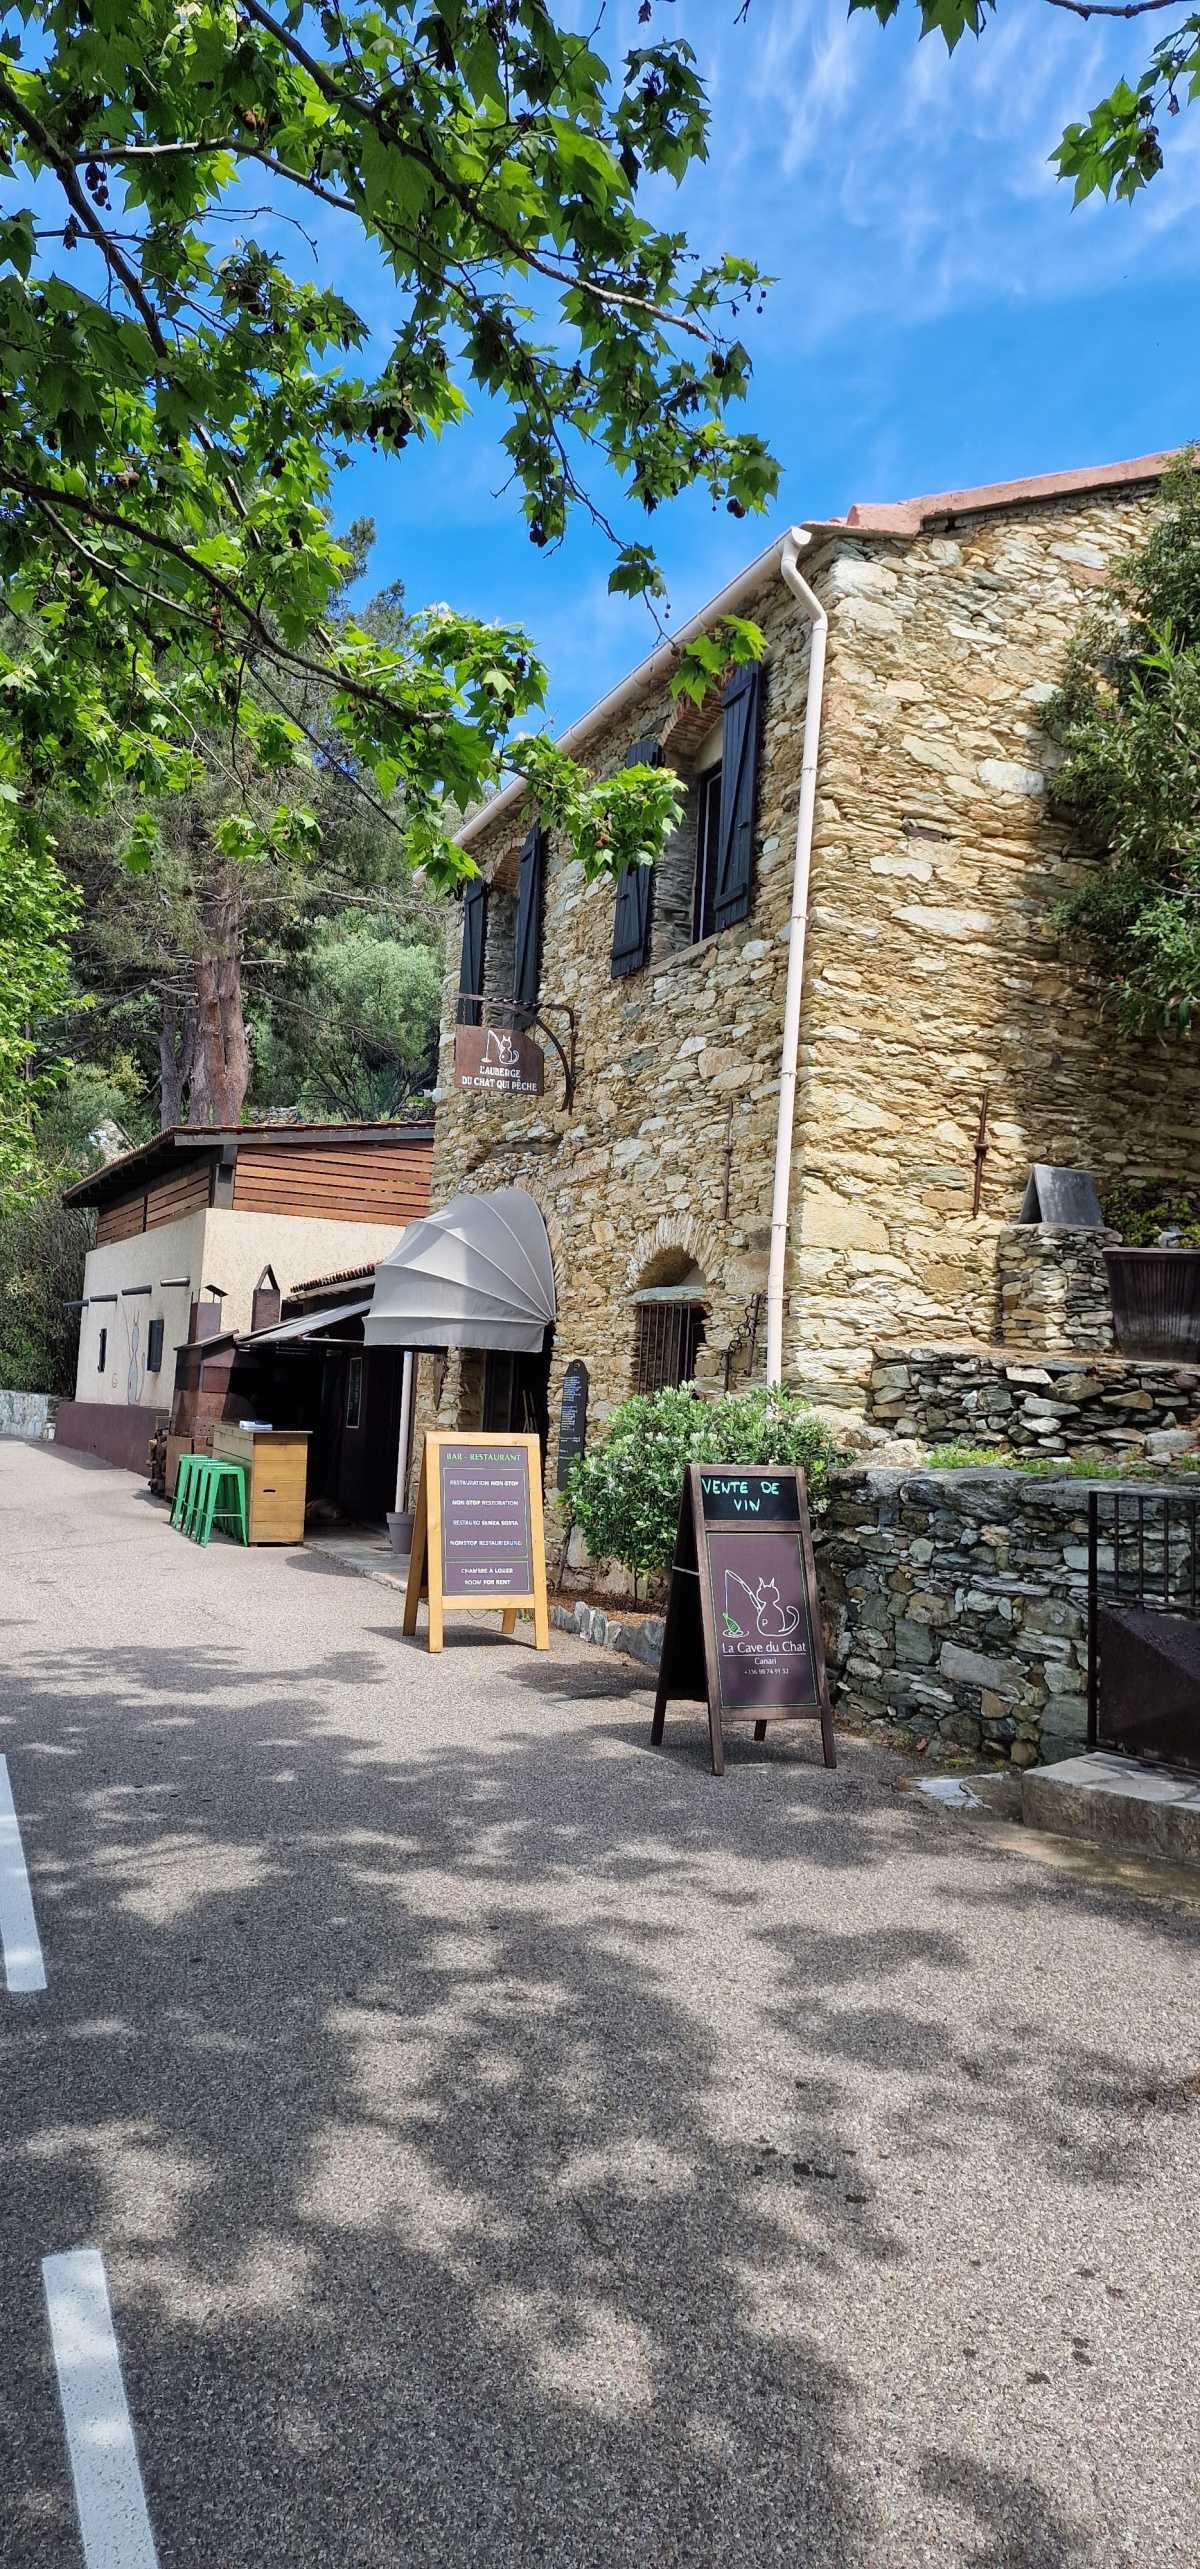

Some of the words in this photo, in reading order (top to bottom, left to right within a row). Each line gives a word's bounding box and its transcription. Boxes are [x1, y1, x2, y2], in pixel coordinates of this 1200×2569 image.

[462, 1075, 473, 1086] DU
[473, 1077, 496, 1088] CHAT
[496, 1080, 510, 1090] QUI
[511, 1079, 538, 1092] PÊCHE
[446, 1453, 462, 1461] BAR
[470, 1453, 521, 1462] RESTAURANT
[701, 1478, 748, 1494] VENTE
[760, 1481, 781, 1495] DE
[733, 1498, 760, 1512] VIN
[722, 1642, 734, 1653] La
[737, 1641, 763, 1653] Cave
[766, 1641, 779, 1653] du
[782, 1640, 807, 1652] Chat
[754, 1656, 777, 1665] Canari
